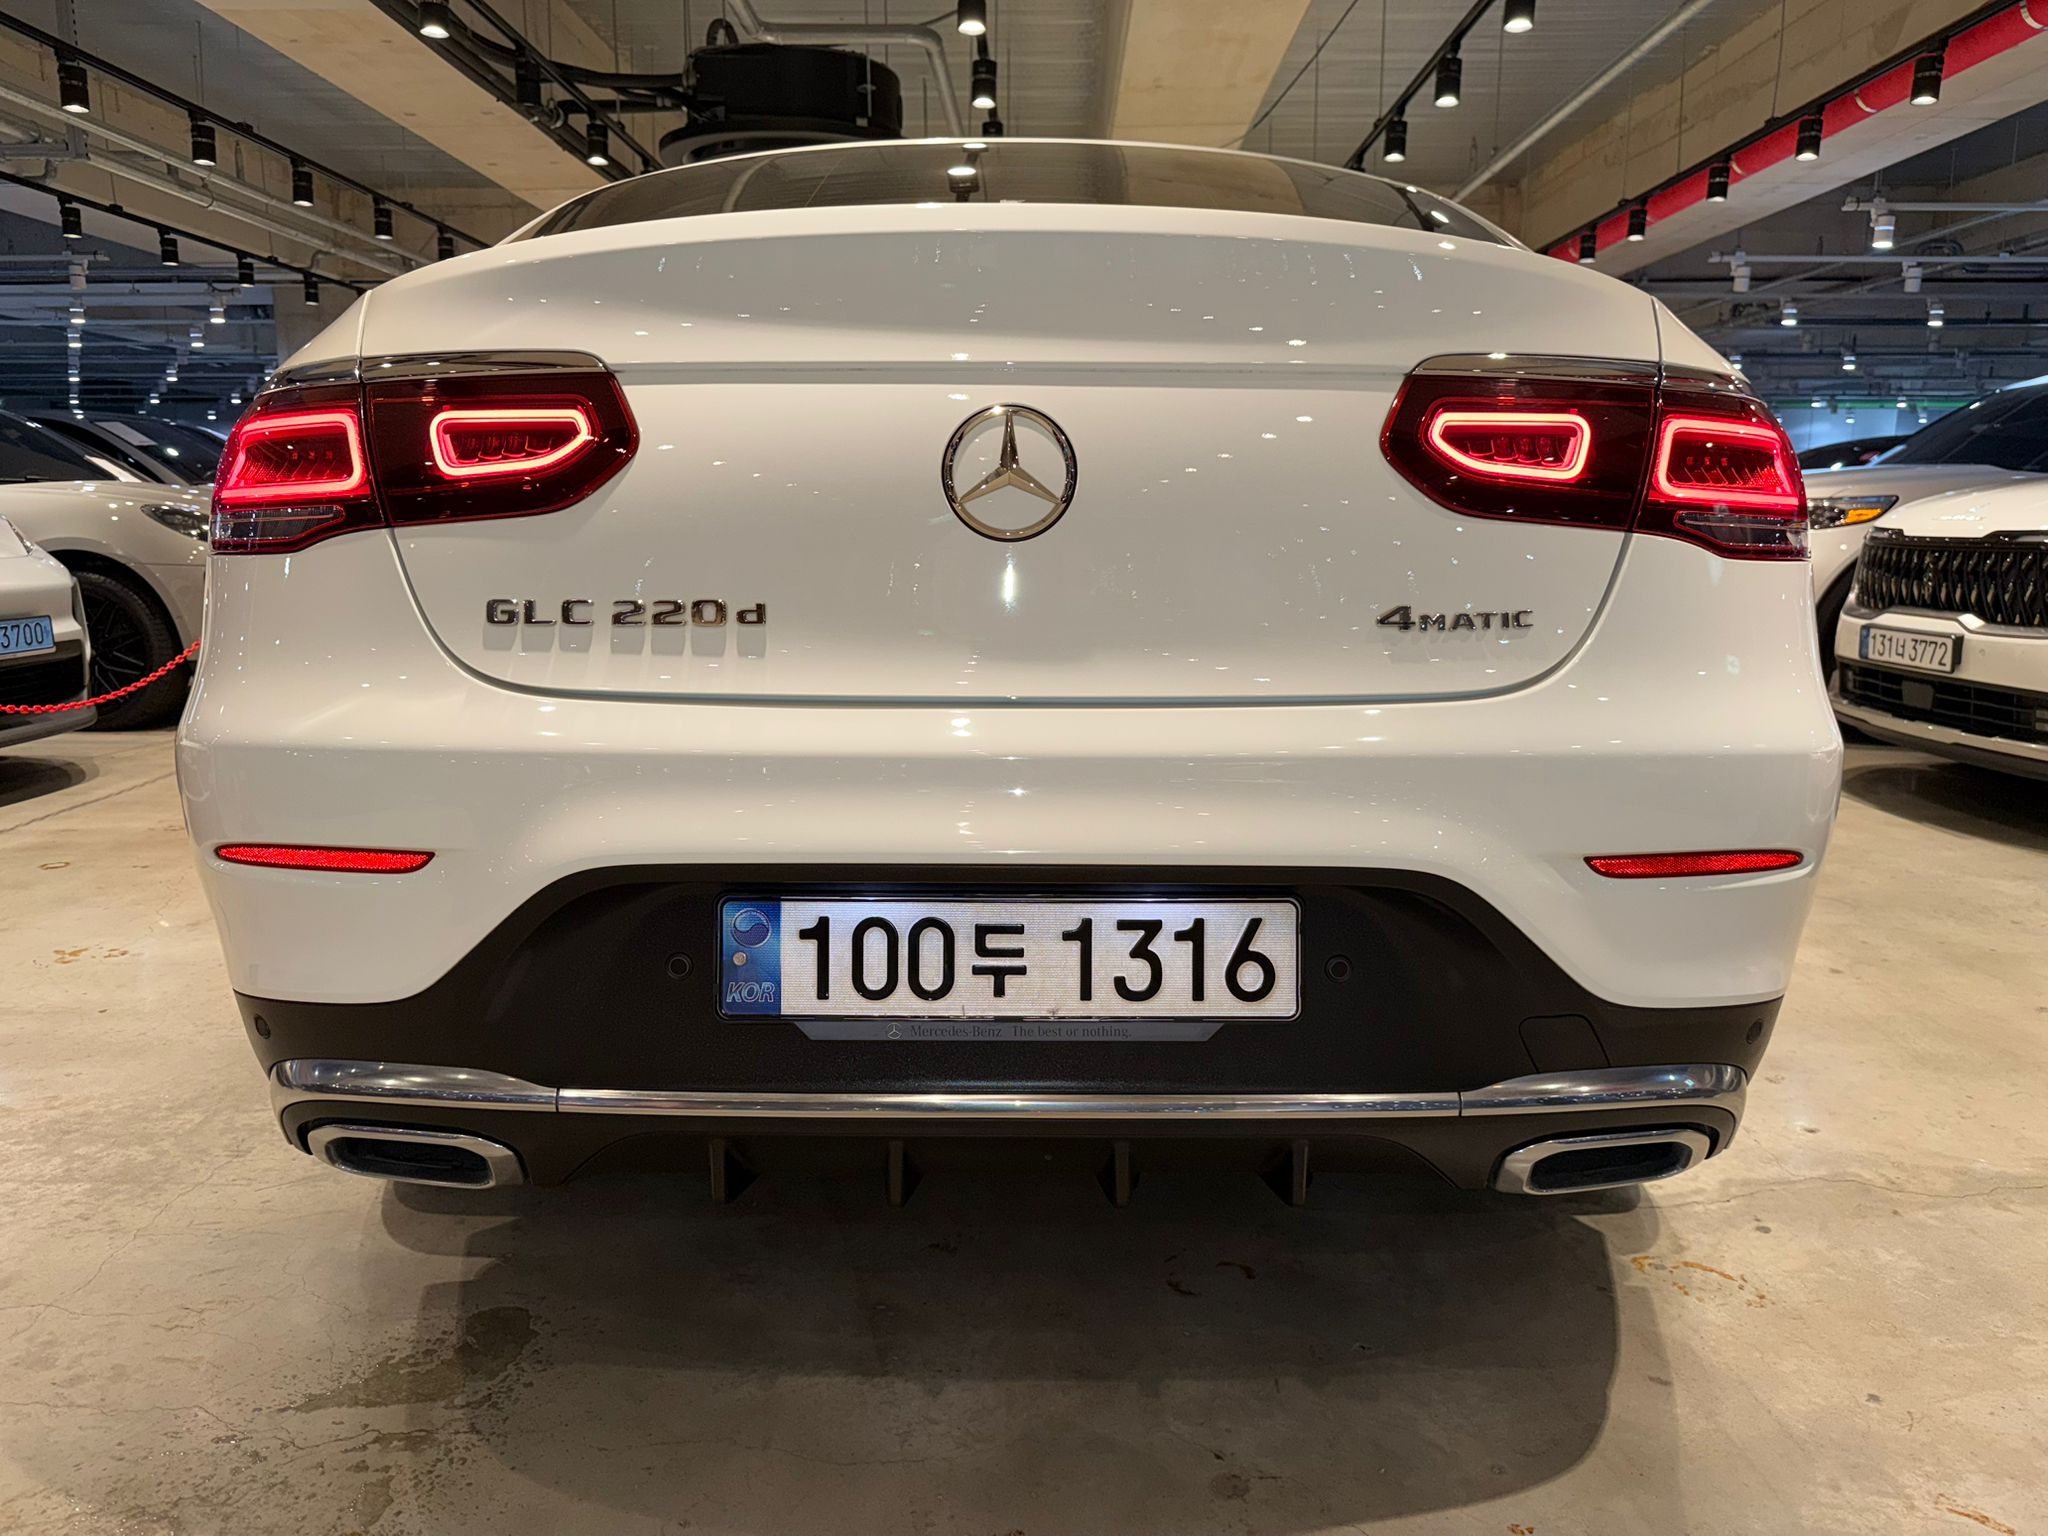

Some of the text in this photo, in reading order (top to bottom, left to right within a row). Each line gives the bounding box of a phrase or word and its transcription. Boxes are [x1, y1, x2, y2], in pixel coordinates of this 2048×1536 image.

[486, 599, 767, 626] GLC 220d
[1376, 605, 1534, 631] 4MATIC
[0, 622, 44, 648] 3700
[1871, 633, 1948, 667] 131너 3772
[799, 916, 1277, 1001] 100두 1316
[726, 981, 776, 1003] KOR
[910, 1024, 1132, 1040] Mercedes-Benz The best or nothing.
